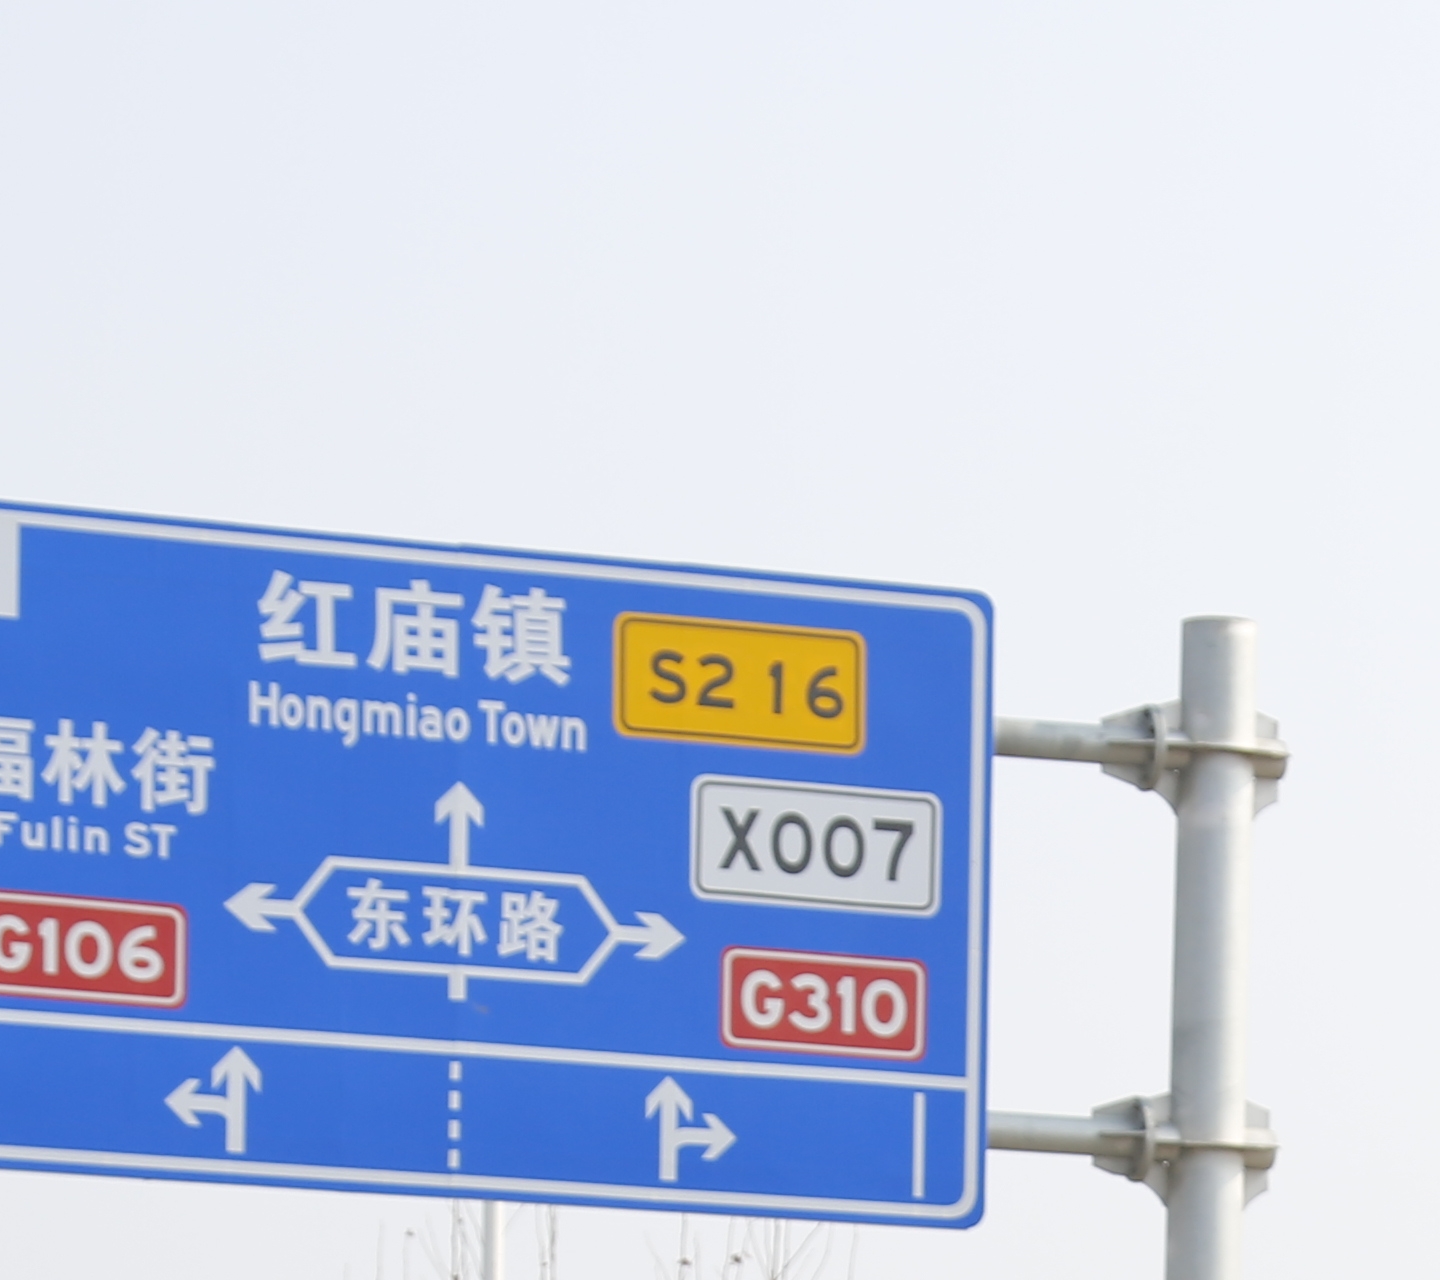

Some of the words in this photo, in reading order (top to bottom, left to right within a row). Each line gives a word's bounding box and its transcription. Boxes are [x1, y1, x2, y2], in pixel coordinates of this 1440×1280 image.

[256, 570, 572, 687] 红庙镇
[248, 681, 469, 748] Hongmiao
[477, 698, 589, 753] Town
[646, 648, 846, 718] S216
[123, 821, 178, 860] ST
[717, 805, 917, 884] X007
[346, 879, 565, 963] 东环路
[739, 969, 910, 1038] G310
